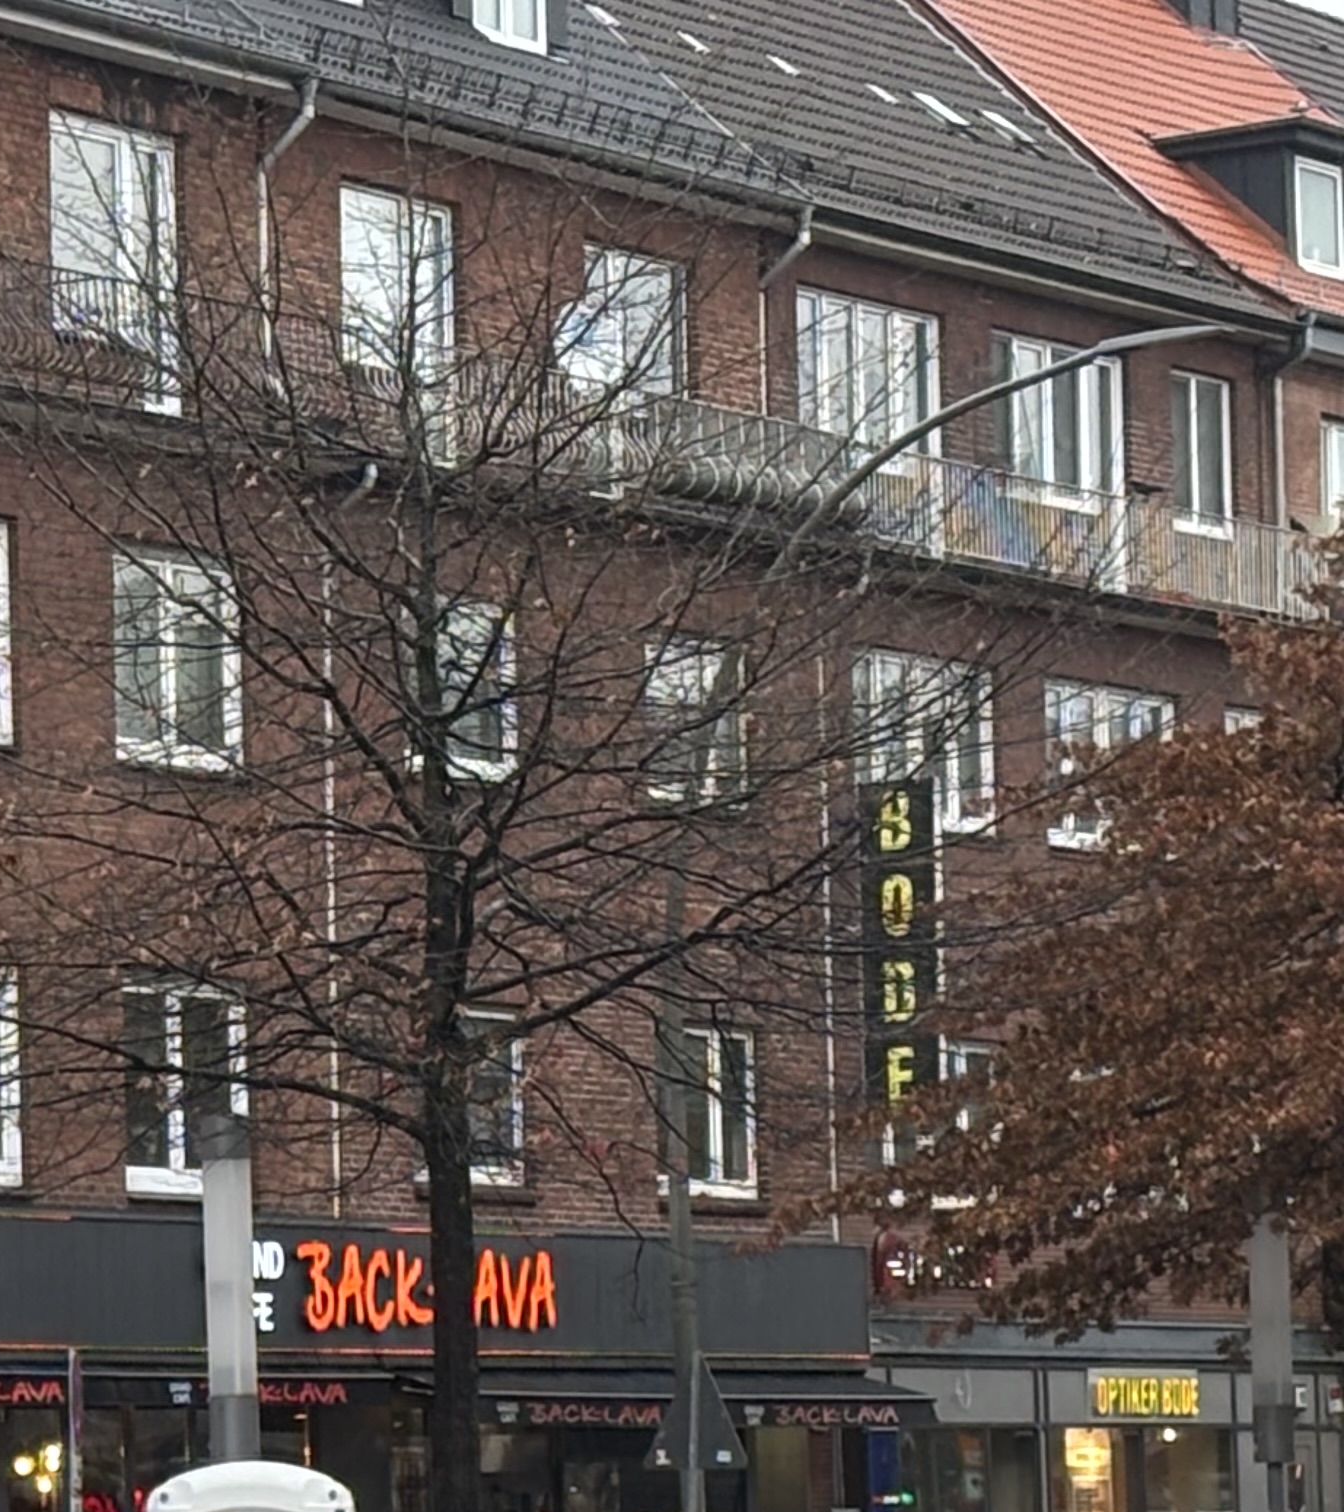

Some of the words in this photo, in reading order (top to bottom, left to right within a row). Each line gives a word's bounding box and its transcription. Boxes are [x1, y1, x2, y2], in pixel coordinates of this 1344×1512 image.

[297, 1240, 557, 1332] BACK-AVA
[1096, 1377, 1159, 1415] OPTIKER
[1162, 1378, 1200, 1415] BODE
